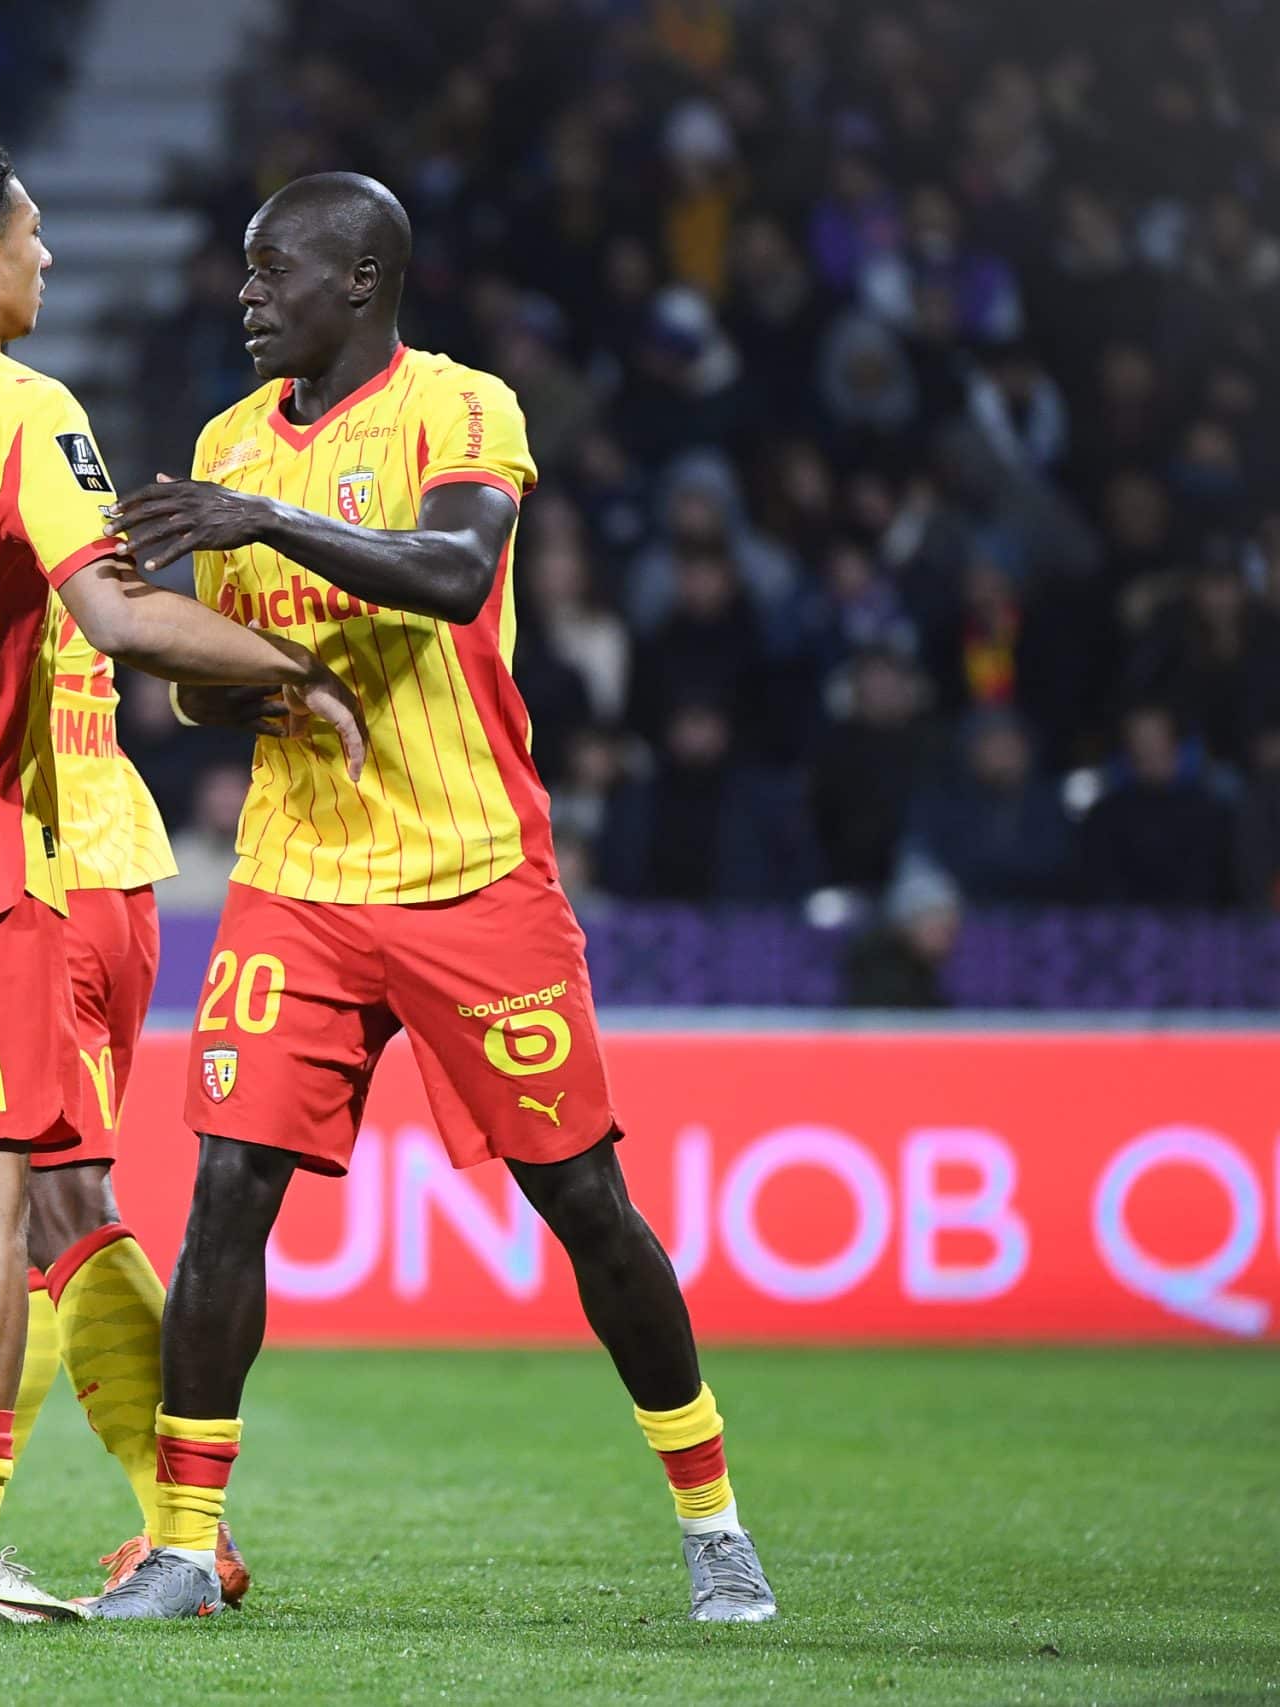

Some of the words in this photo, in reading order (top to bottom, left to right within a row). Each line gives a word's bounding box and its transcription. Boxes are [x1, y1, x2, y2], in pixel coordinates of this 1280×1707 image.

[328, 420, 398, 443] Nexans
[198, 950, 286, 1034] 20
[457, 980, 568, 1018] boulanger
[204, 1062, 221, 1098] RCL
[672, 1124, 1031, 1302] JOB
[1092, 1123, 1280, 1340] Q
